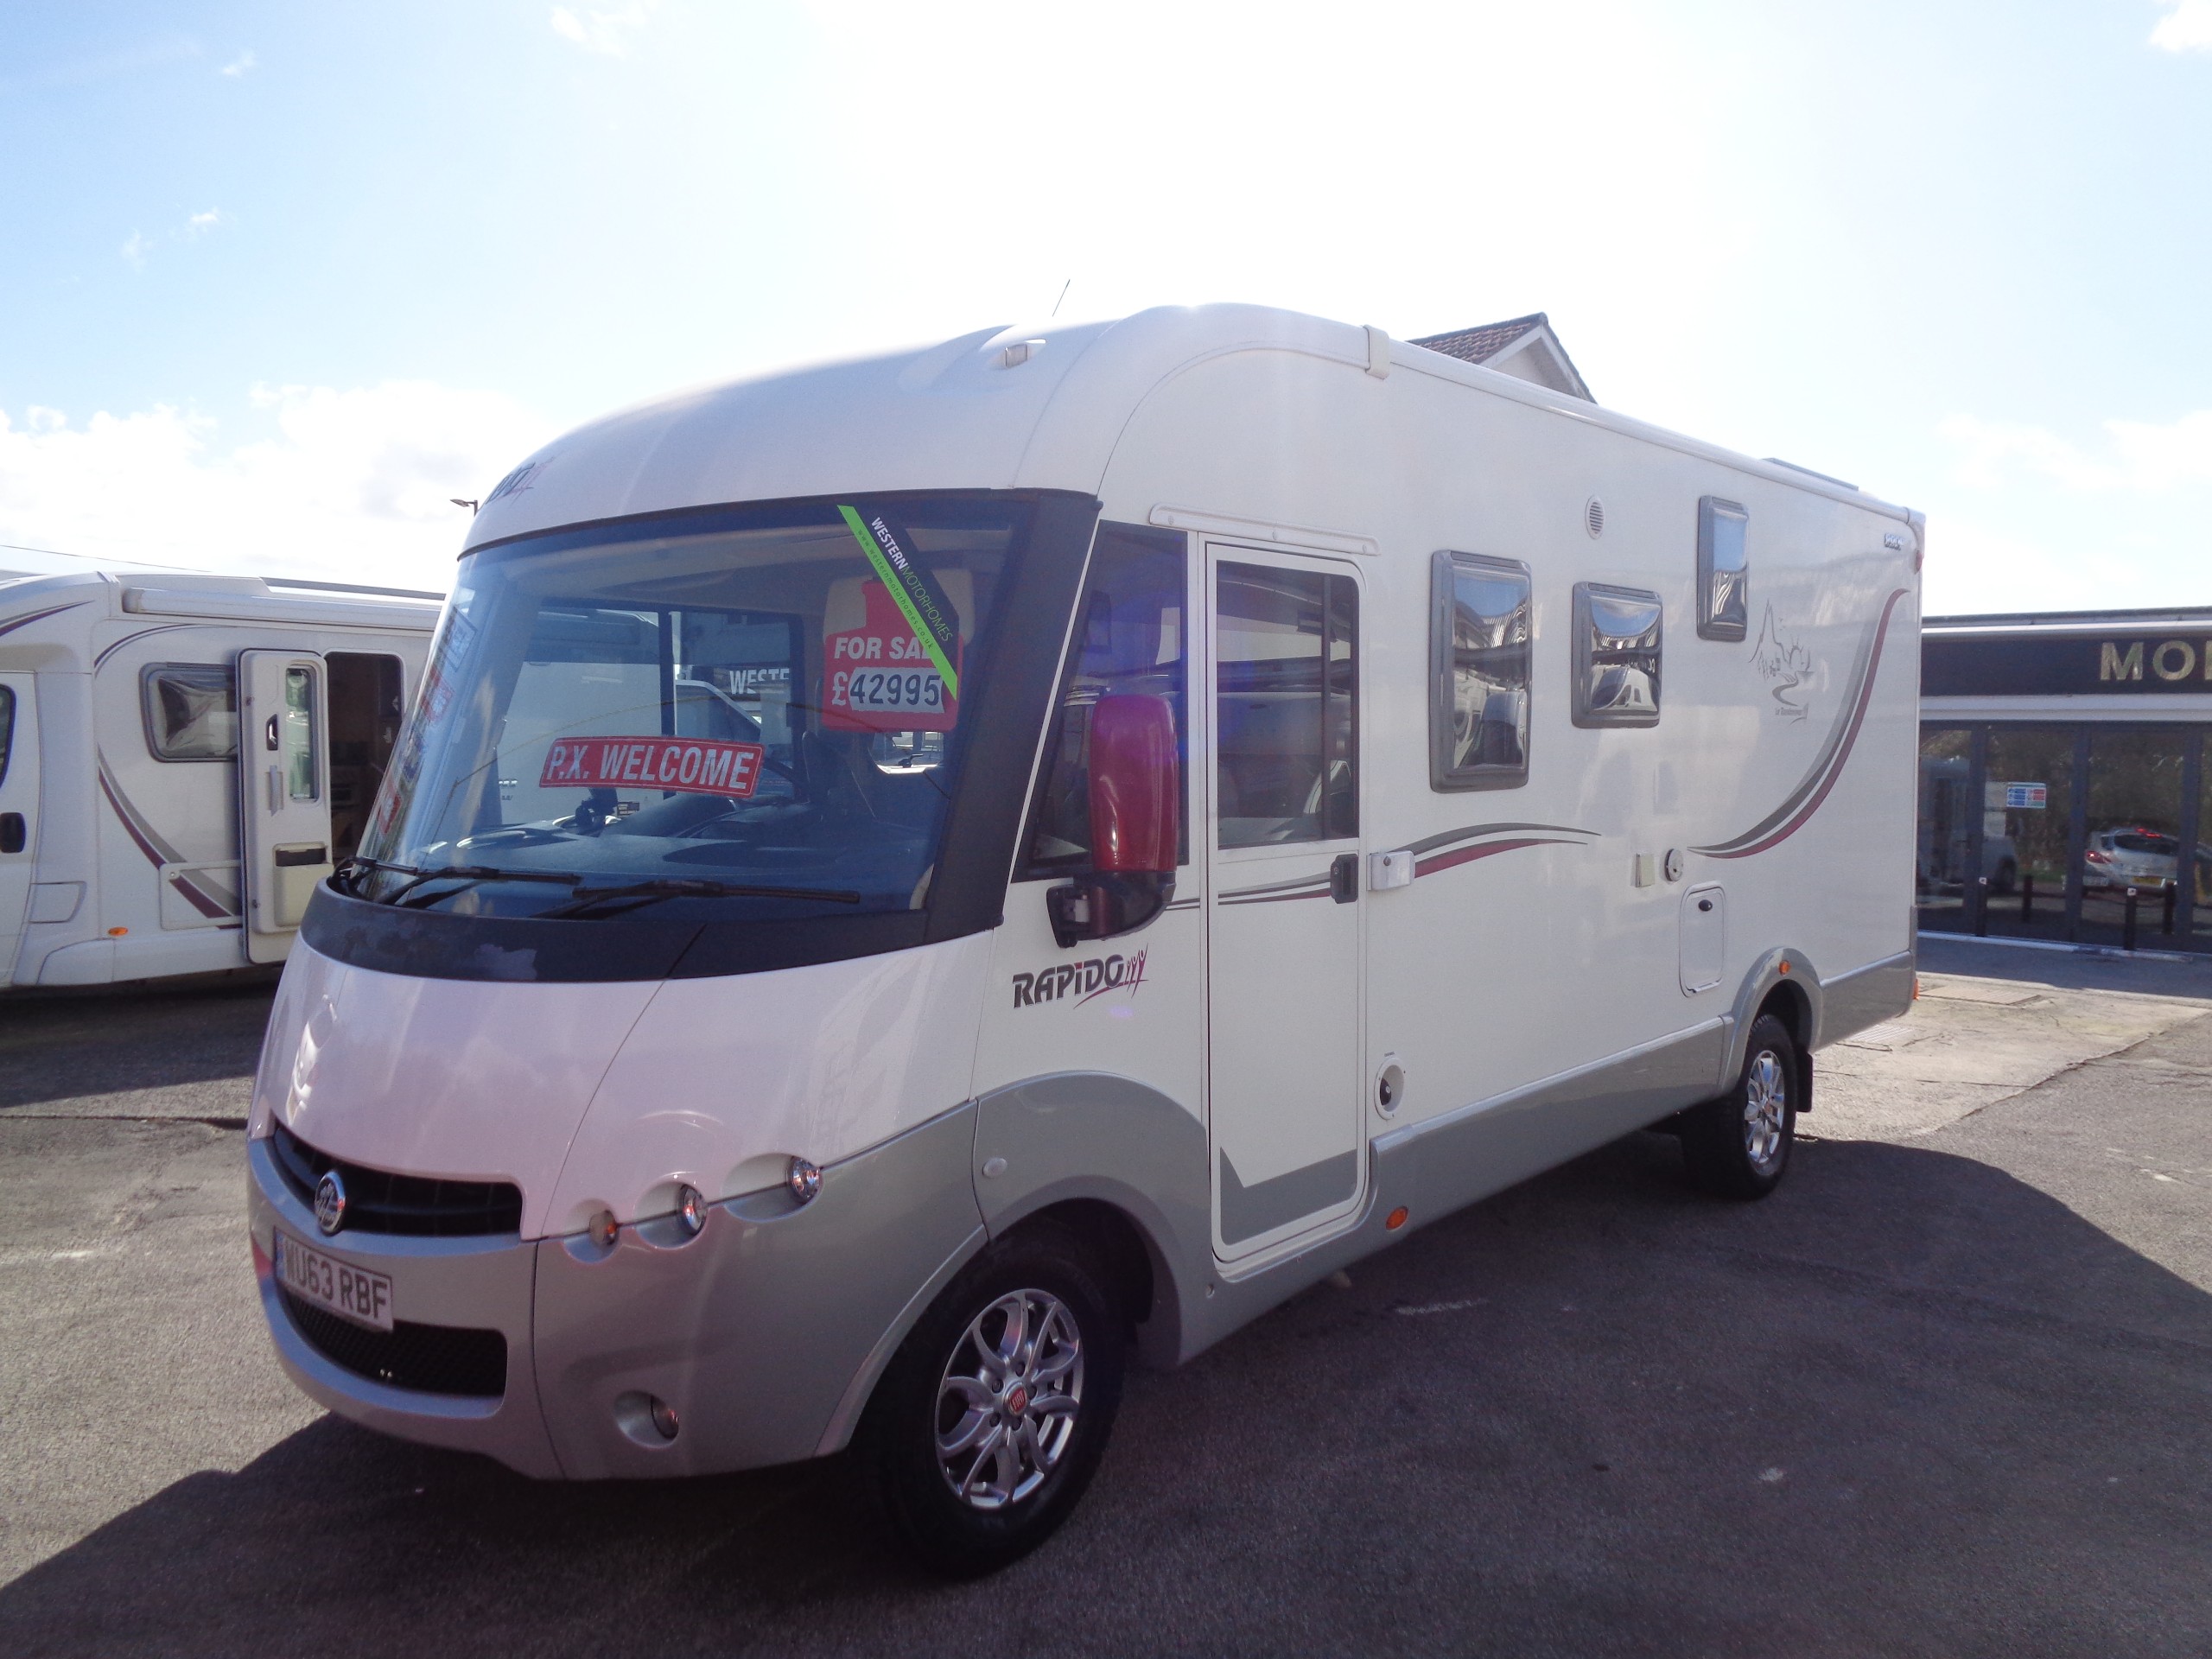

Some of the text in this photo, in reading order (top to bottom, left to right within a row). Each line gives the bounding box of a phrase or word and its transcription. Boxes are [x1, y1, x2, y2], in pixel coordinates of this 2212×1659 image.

[872, 517, 952, 641] WESTERNMOTORHOMES
[834, 637, 931, 659] FOR SAL
[2101, 640, 2212, 680] MO
[832, 671, 941, 706] £42995
[546, 744, 754, 790] P.X. WELCOME
[340, 1268, 388, 1319] RBF
